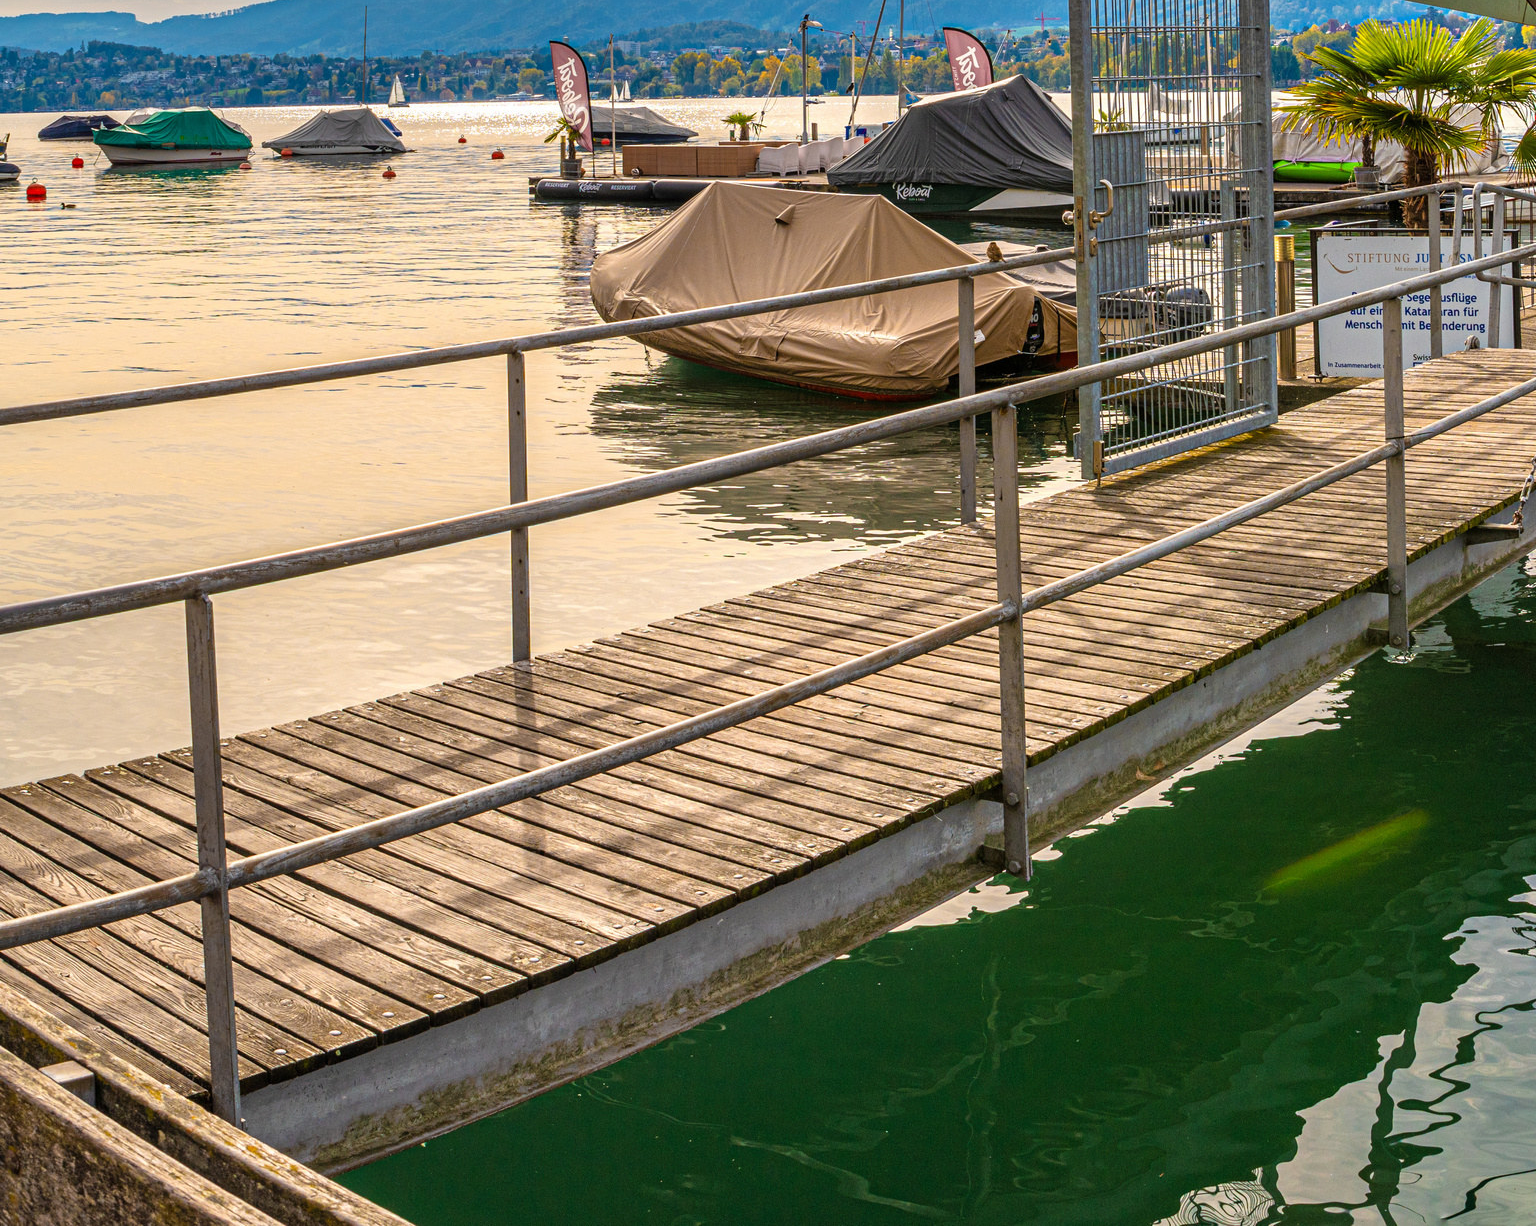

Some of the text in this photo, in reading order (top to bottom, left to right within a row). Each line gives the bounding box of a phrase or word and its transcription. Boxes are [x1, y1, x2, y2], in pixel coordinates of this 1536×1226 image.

[892, 182, 934, 200] Reboat
[1347, 253, 1410, 263] STIFTUNG
[1415, 253, 1444, 263] JUT
[1463, 306, 1479, 317] für
